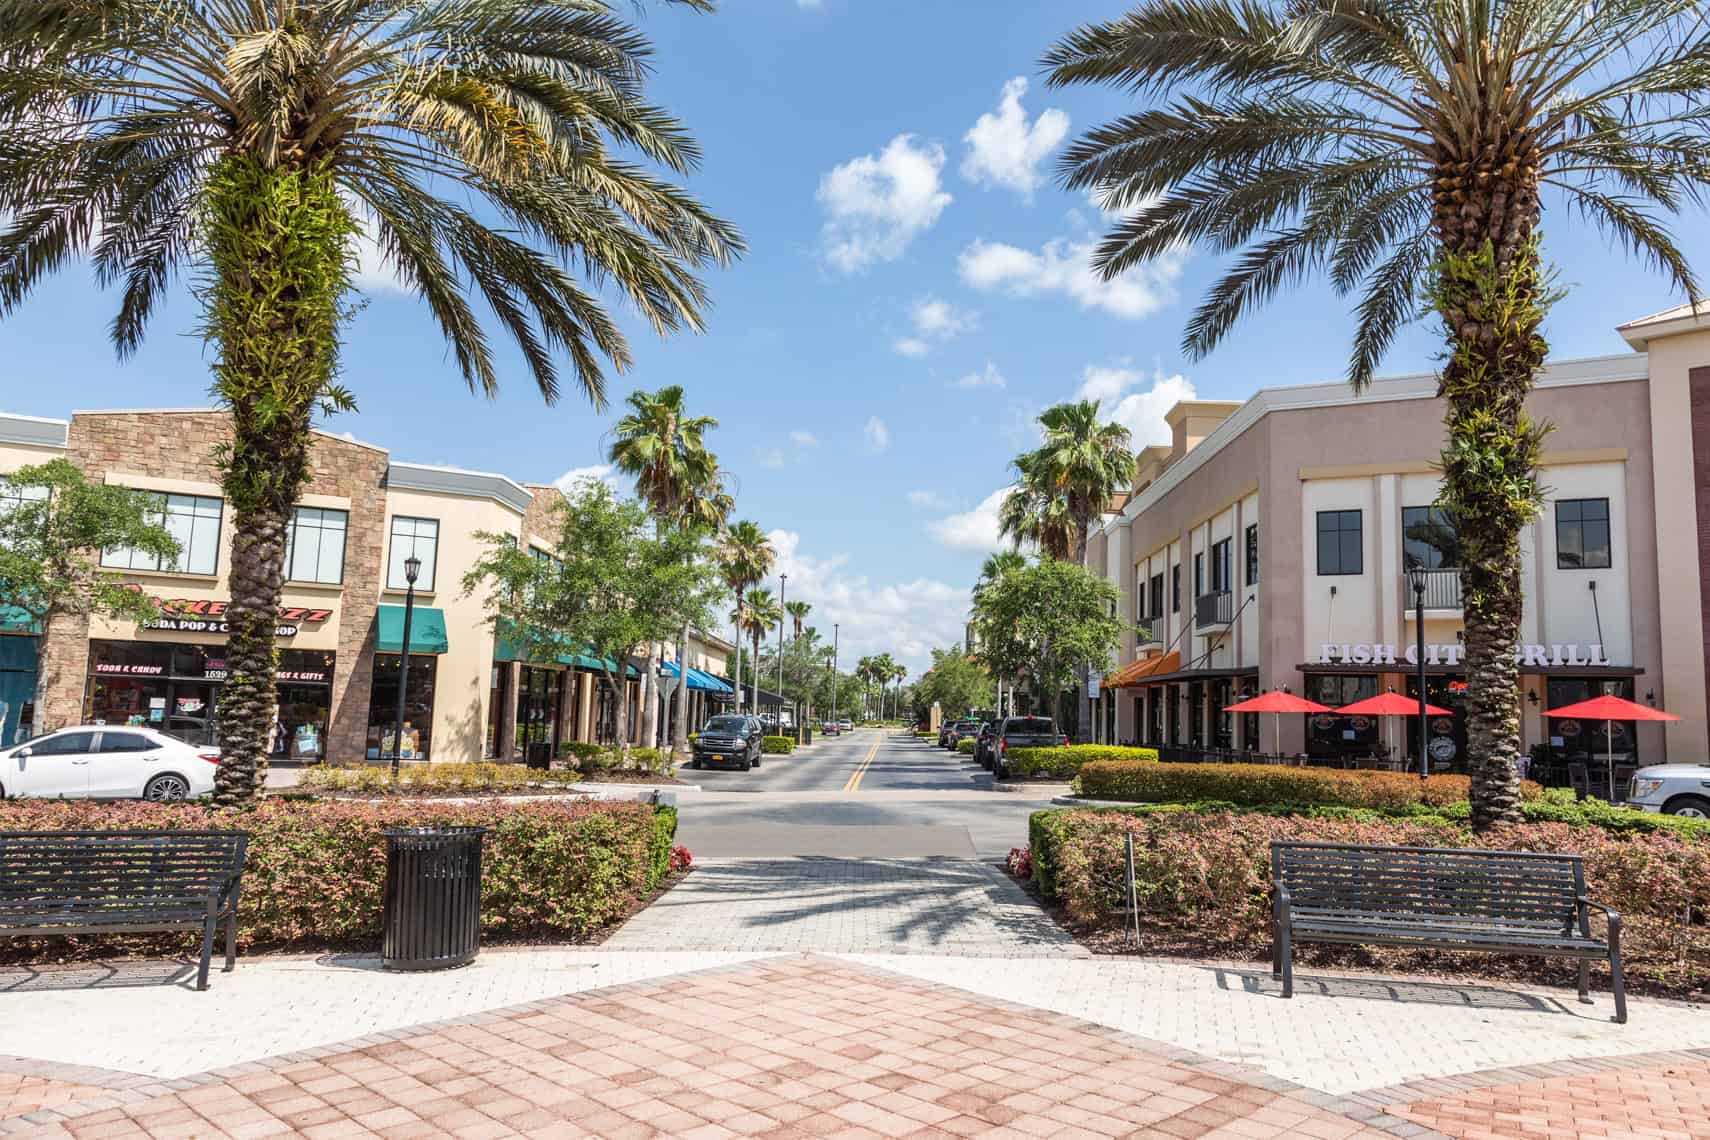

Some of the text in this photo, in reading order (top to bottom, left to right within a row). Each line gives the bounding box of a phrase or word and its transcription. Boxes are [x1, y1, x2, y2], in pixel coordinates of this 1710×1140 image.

[179, 621, 206, 631] POP
[208, 623, 217, 631] &
[1320, 643, 1396, 665] FISH
[1405, 644, 1466, 666] CIT
[131, 665, 162, 674] CANDY
[300, 672, 324, 680] GIFTS
